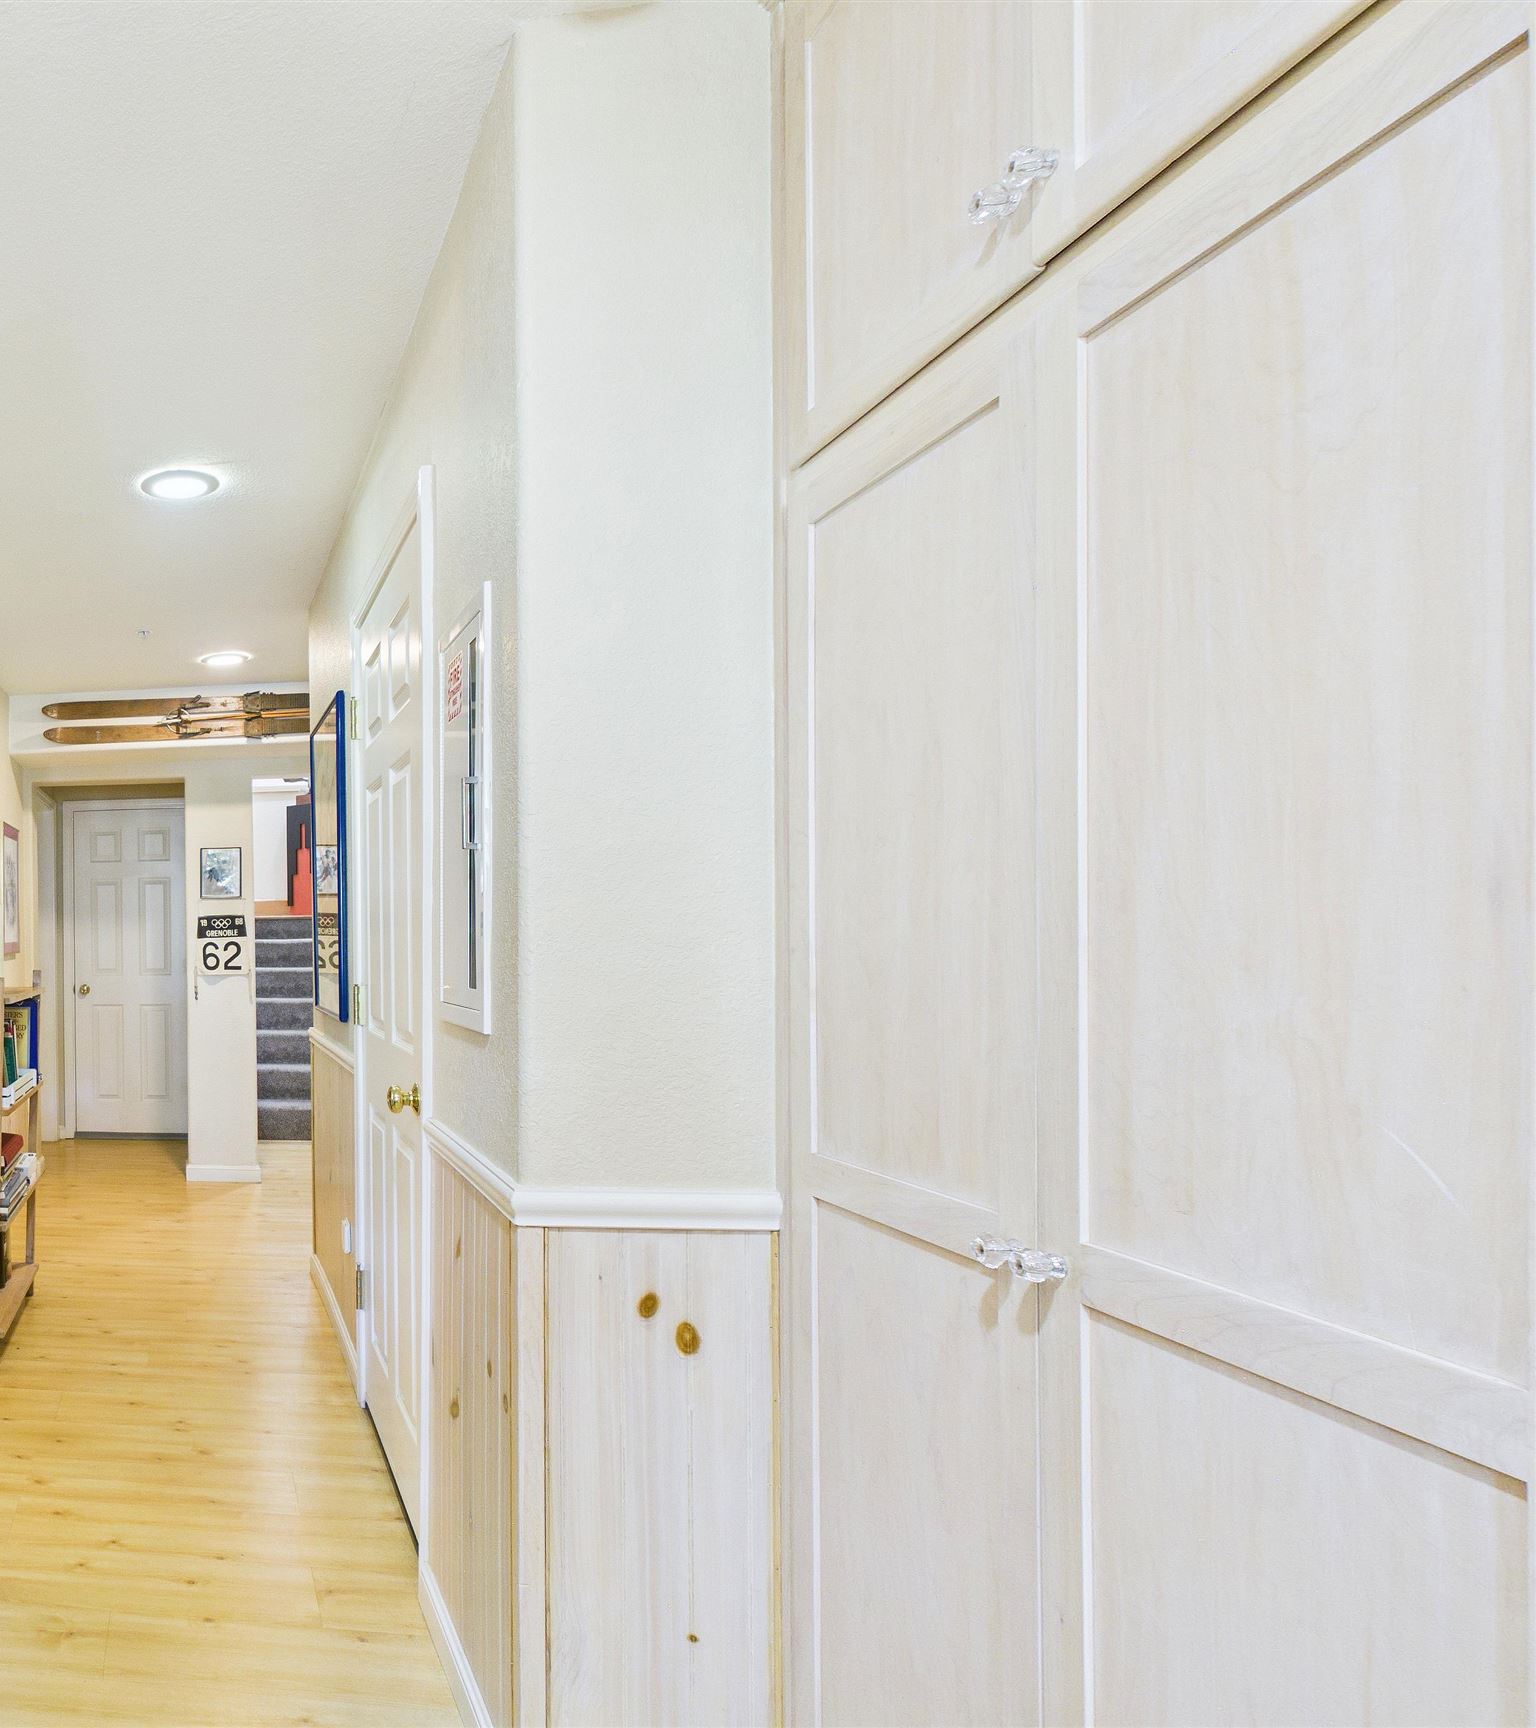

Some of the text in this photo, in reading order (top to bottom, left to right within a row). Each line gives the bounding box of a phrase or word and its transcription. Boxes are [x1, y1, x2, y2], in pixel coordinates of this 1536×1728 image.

[199, 919, 208, 927] 19
[206, 929, 239, 938] GRENOBLE
[202, 941, 242, 971] 62
